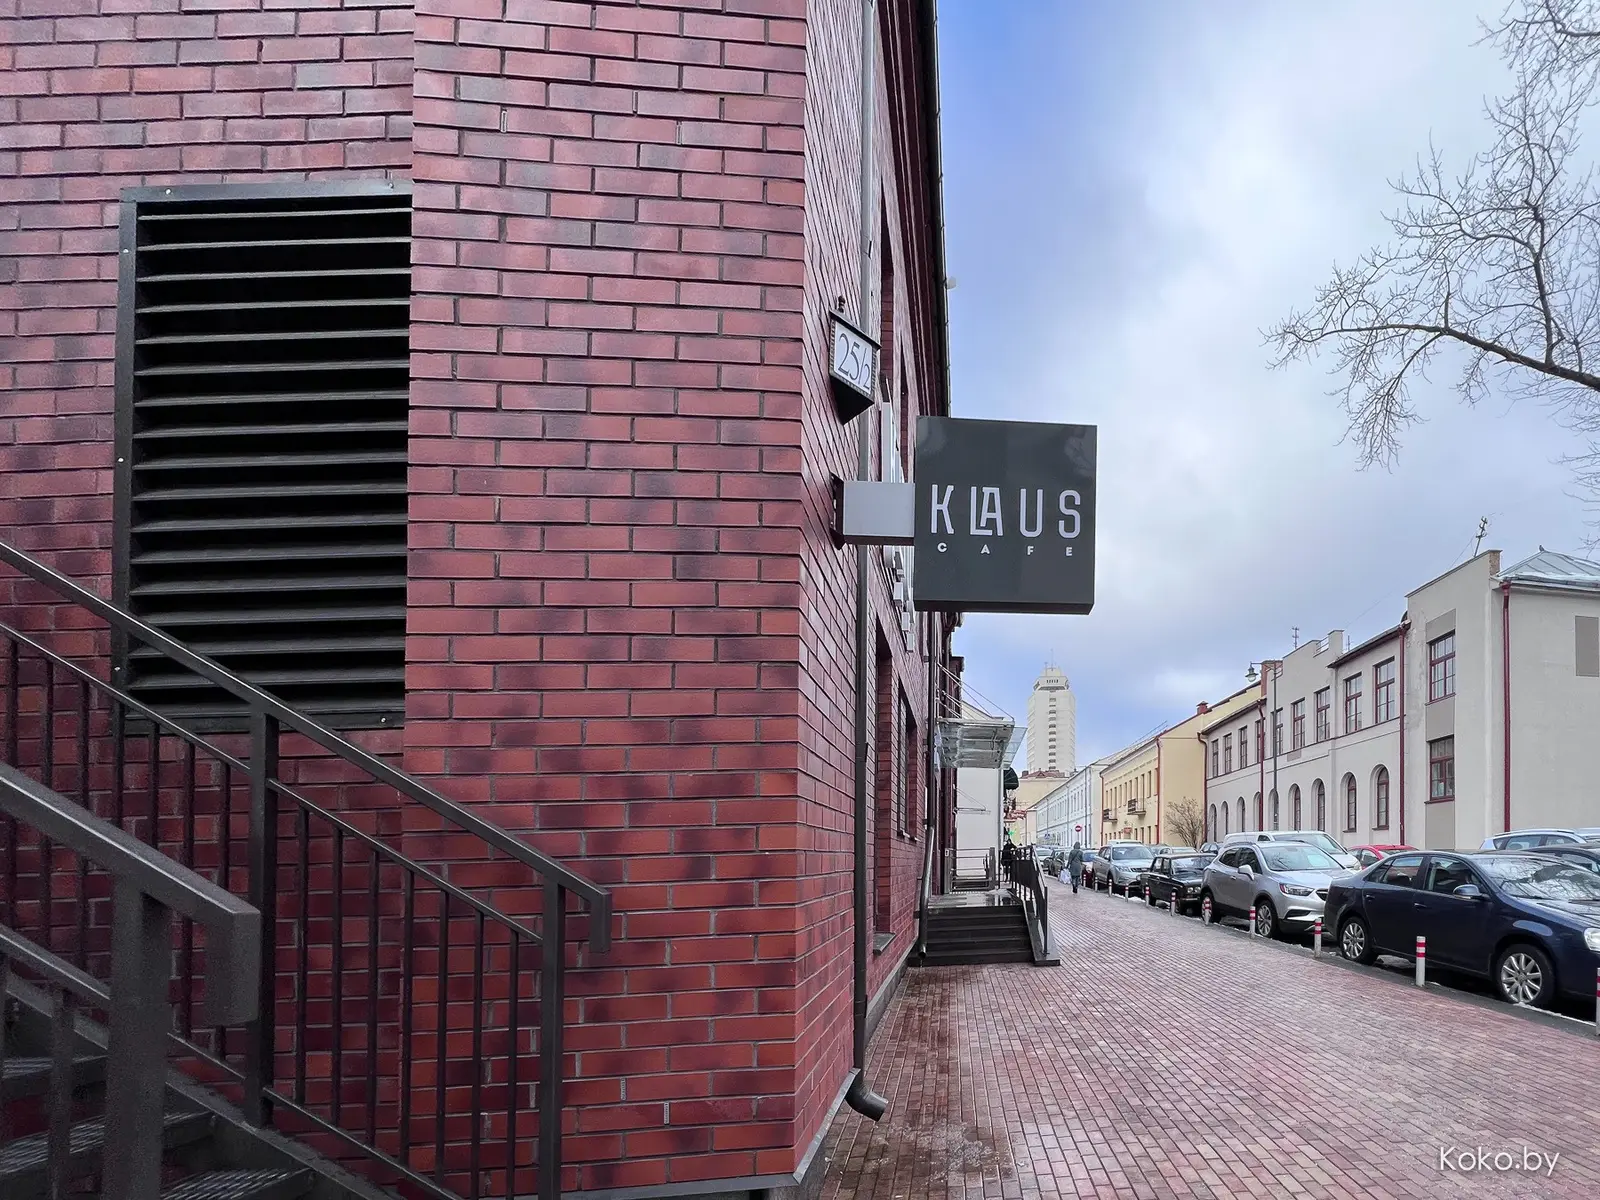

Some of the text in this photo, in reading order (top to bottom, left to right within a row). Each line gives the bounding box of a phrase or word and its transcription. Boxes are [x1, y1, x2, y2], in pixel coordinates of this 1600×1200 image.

[838, 333, 871, 390] 25/2
[930, 484, 1081, 539] KLAUS
[937, 542, 1073, 557] CAFE
